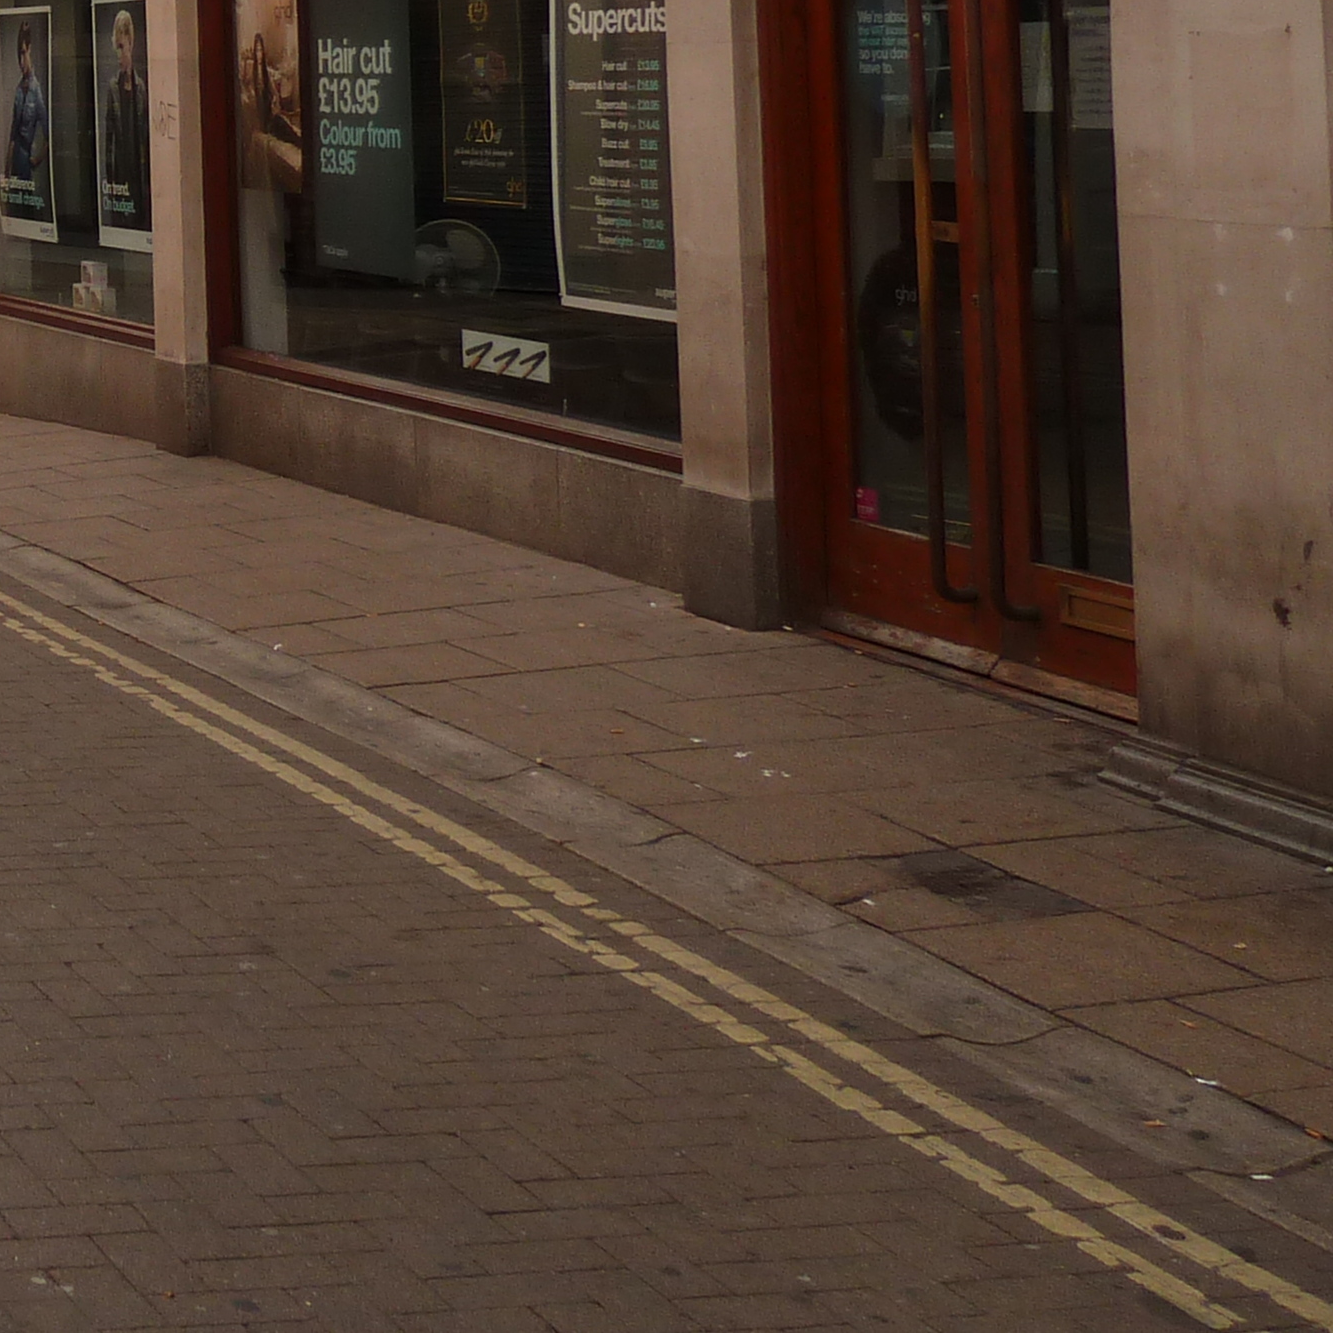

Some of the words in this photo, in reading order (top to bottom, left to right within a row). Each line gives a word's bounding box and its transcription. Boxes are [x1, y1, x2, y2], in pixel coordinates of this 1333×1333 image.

[567, 1, 668, 42] Supercuts
[857, 11, 883, 24] We're
[317, 38, 357, 75] Hair
[359, 39, 393, 75] cut
[871, 50, 889, 63] you
[318, 77, 380, 115] £13.95
[319, 118, 366, 148] Colour
[366, 120, 402, 149] from
[319, 146, 357, 176] £3.95
